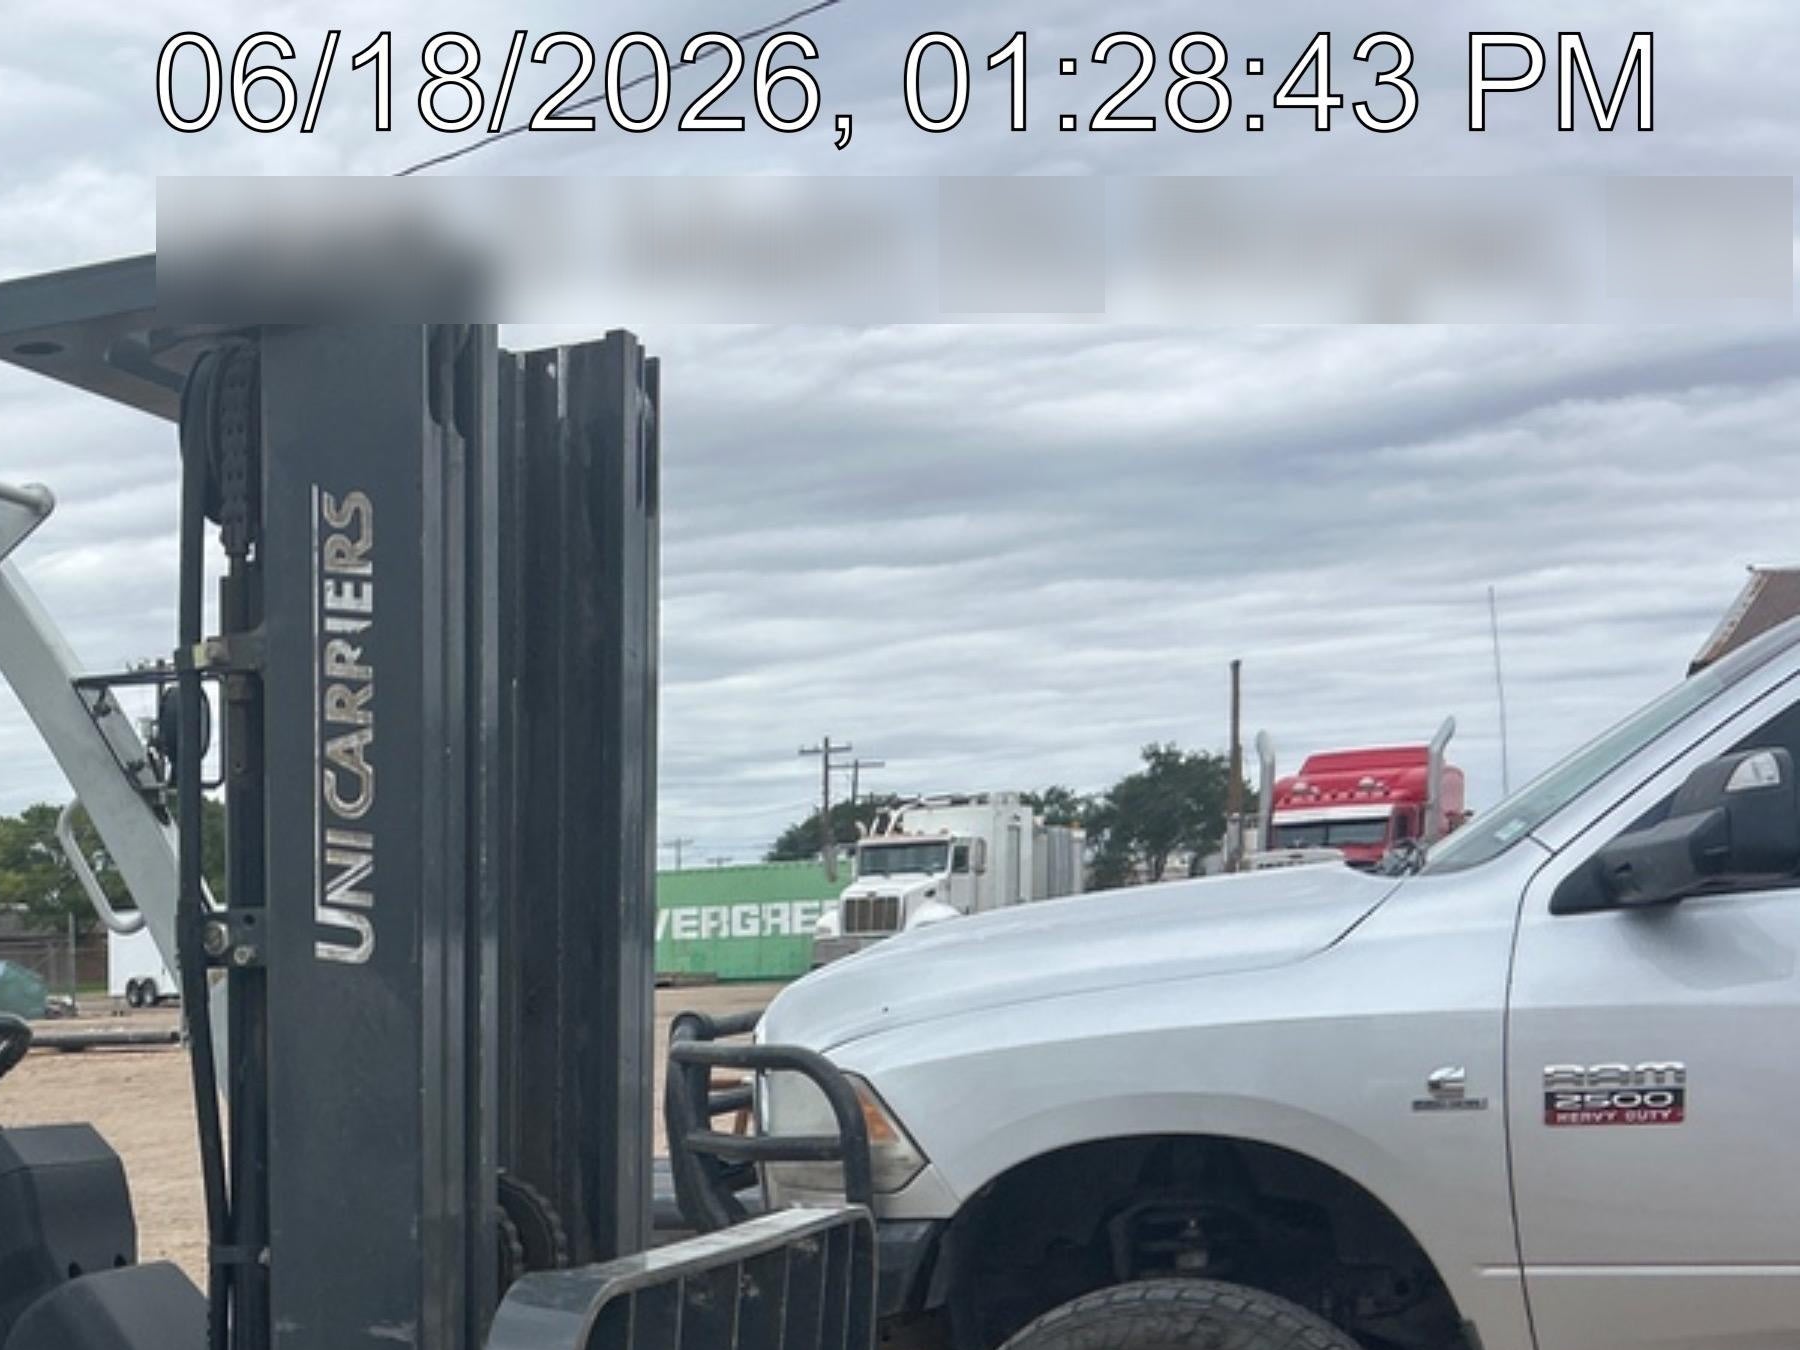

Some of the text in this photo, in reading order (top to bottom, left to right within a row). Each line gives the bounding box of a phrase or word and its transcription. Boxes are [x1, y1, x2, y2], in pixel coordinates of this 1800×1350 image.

[1555, 1090, 1674, 1109] 2500
[1555, 1109, 1673, 1124] HEAVY DUTY
